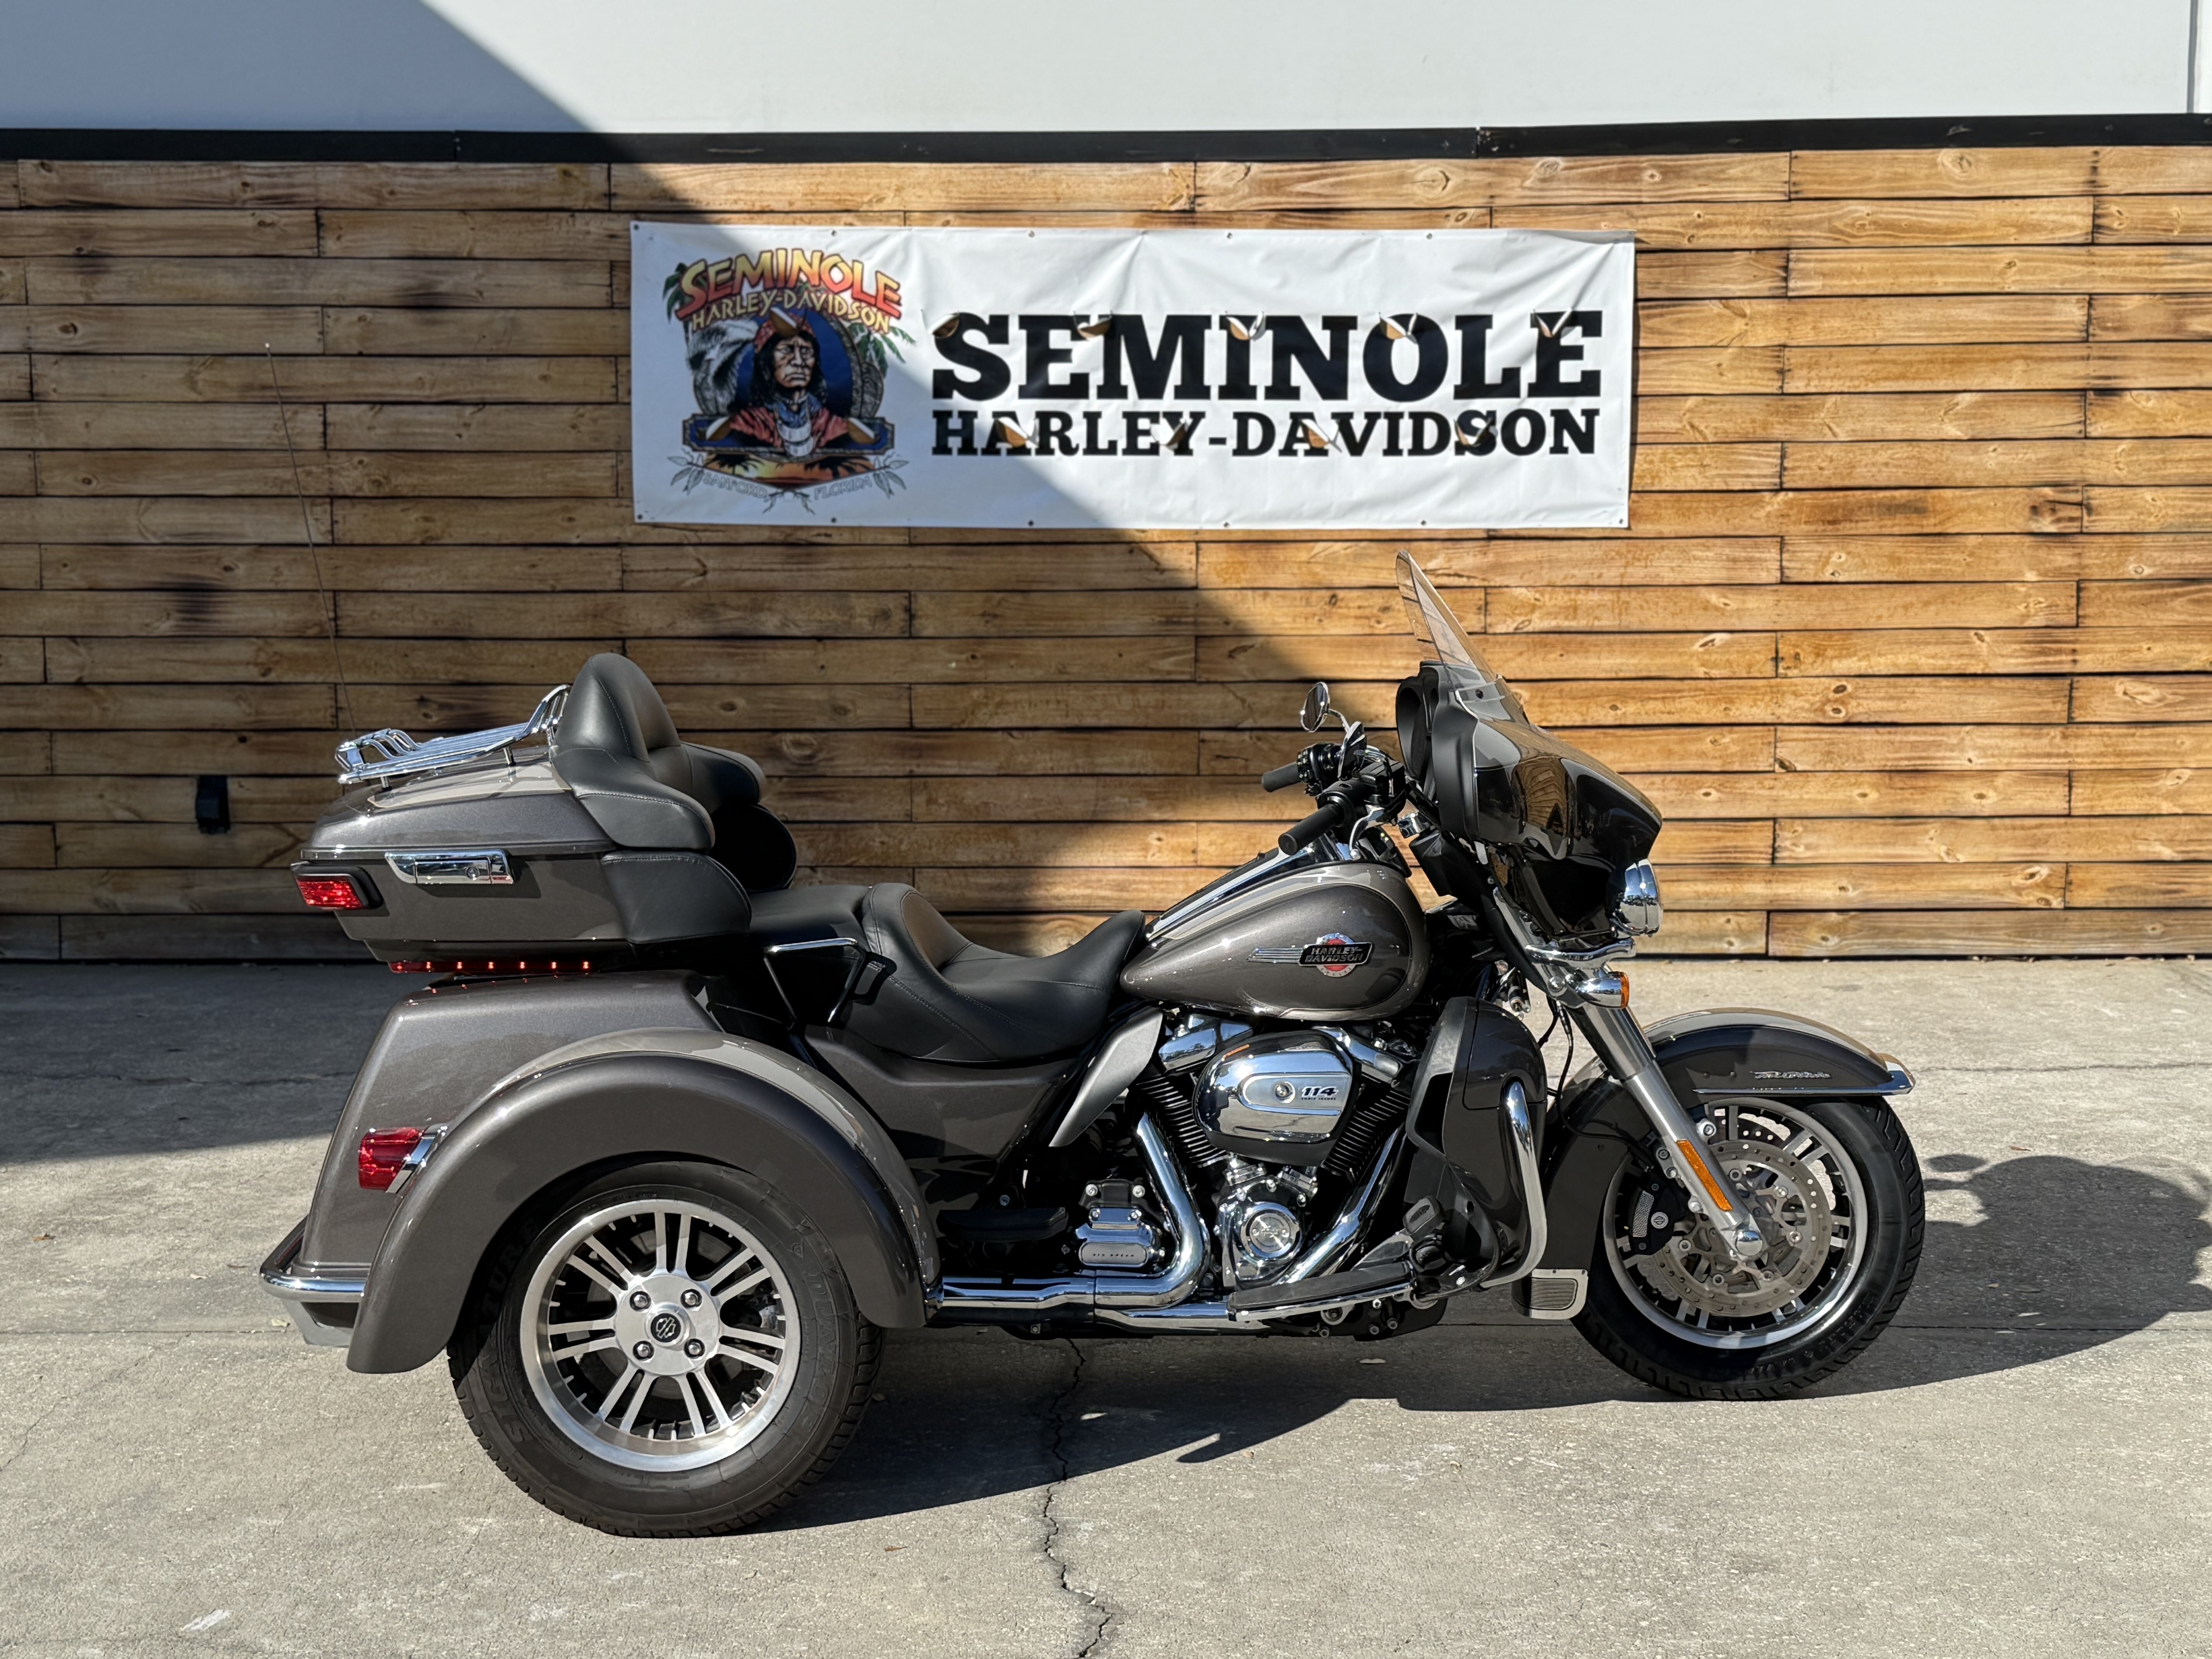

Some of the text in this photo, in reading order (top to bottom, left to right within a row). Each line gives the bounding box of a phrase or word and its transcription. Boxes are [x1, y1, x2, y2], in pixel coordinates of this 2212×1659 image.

[677, 248, 902, 319] SEMINOLE
[692, 289, 891, 334] HARLEY-DAVIDSON
[932, 310, 1602, 402] SEMINOLE
[932, 408, 1600, 456] HARLEY-DAVIDSON
[702, 472, 873, 503] SANFORD, FLORIDA
[1305, 954, 1364, 963] DAVIDSON
[1311, 946, 1363, 955] HARLEY-
[1302, 1086, 1339, 1097] 114
